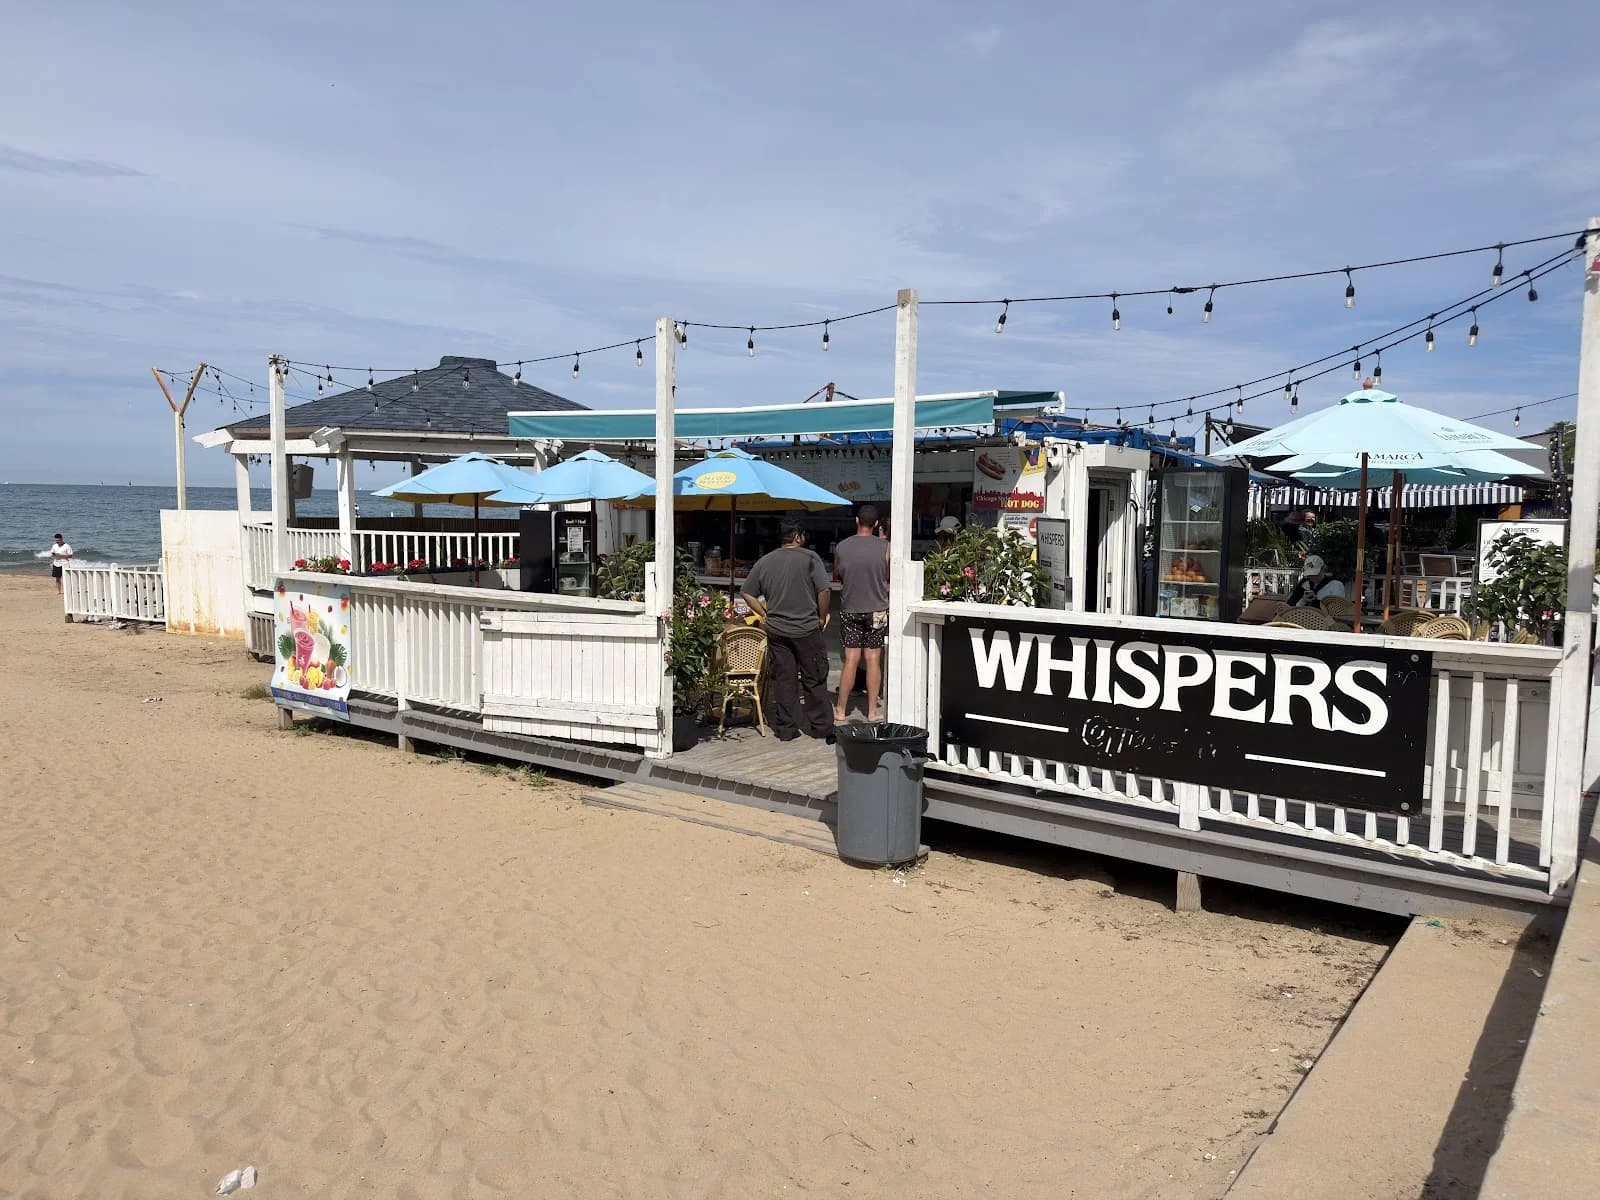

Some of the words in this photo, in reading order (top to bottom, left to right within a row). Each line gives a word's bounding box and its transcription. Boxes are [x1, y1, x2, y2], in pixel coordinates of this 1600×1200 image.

[1000, 499, 1020, 508] HOT
[1021, 500, 1040, 508] DOG
[1040, 532, 1065, 547] WHISPERS
[967, 627, 1390, 736] WHISPERS
